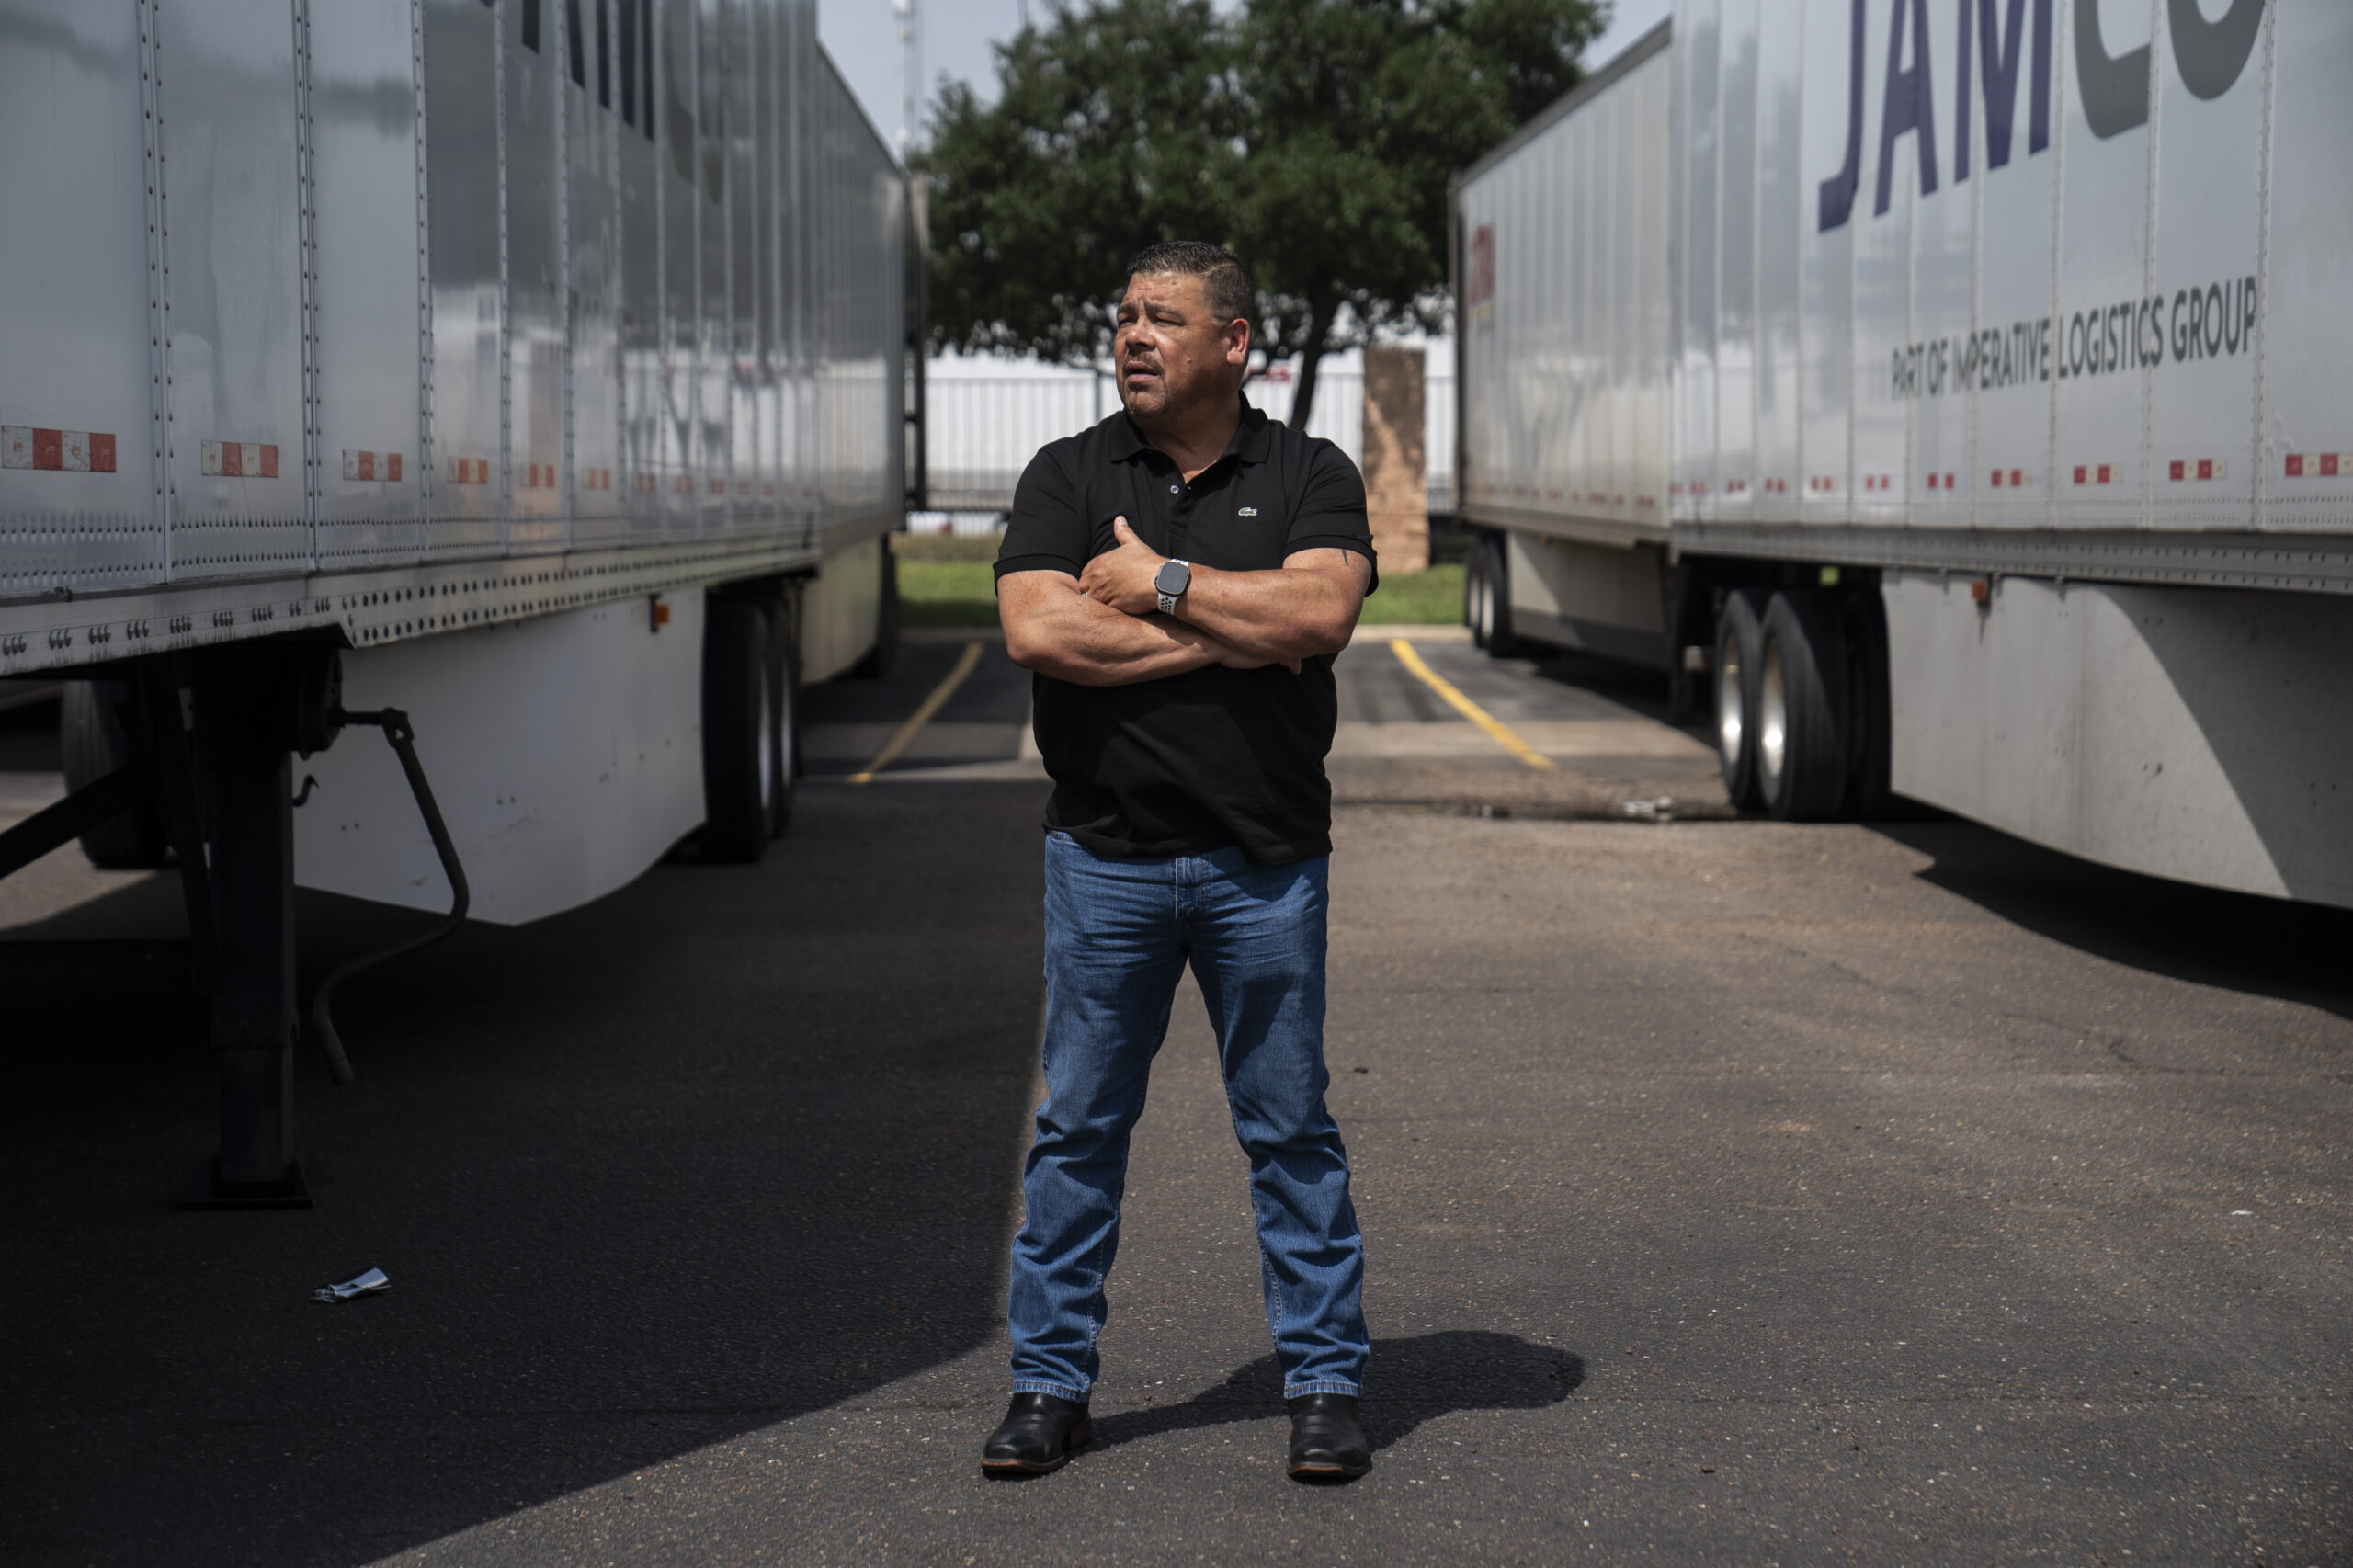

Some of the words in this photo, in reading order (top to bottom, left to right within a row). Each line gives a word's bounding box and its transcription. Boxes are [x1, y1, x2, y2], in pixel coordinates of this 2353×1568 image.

[1819, 0, 2267, 234] JAM
[1892, 341, 1924, 401] PART
[1928, 337, 1949, 396] OF
[1952, 317, 2051, 393] IMPERATIVE
[2058, 294, 2165, 379] LOGISTICS
[2171, 276, 2256, 362] GROUP
